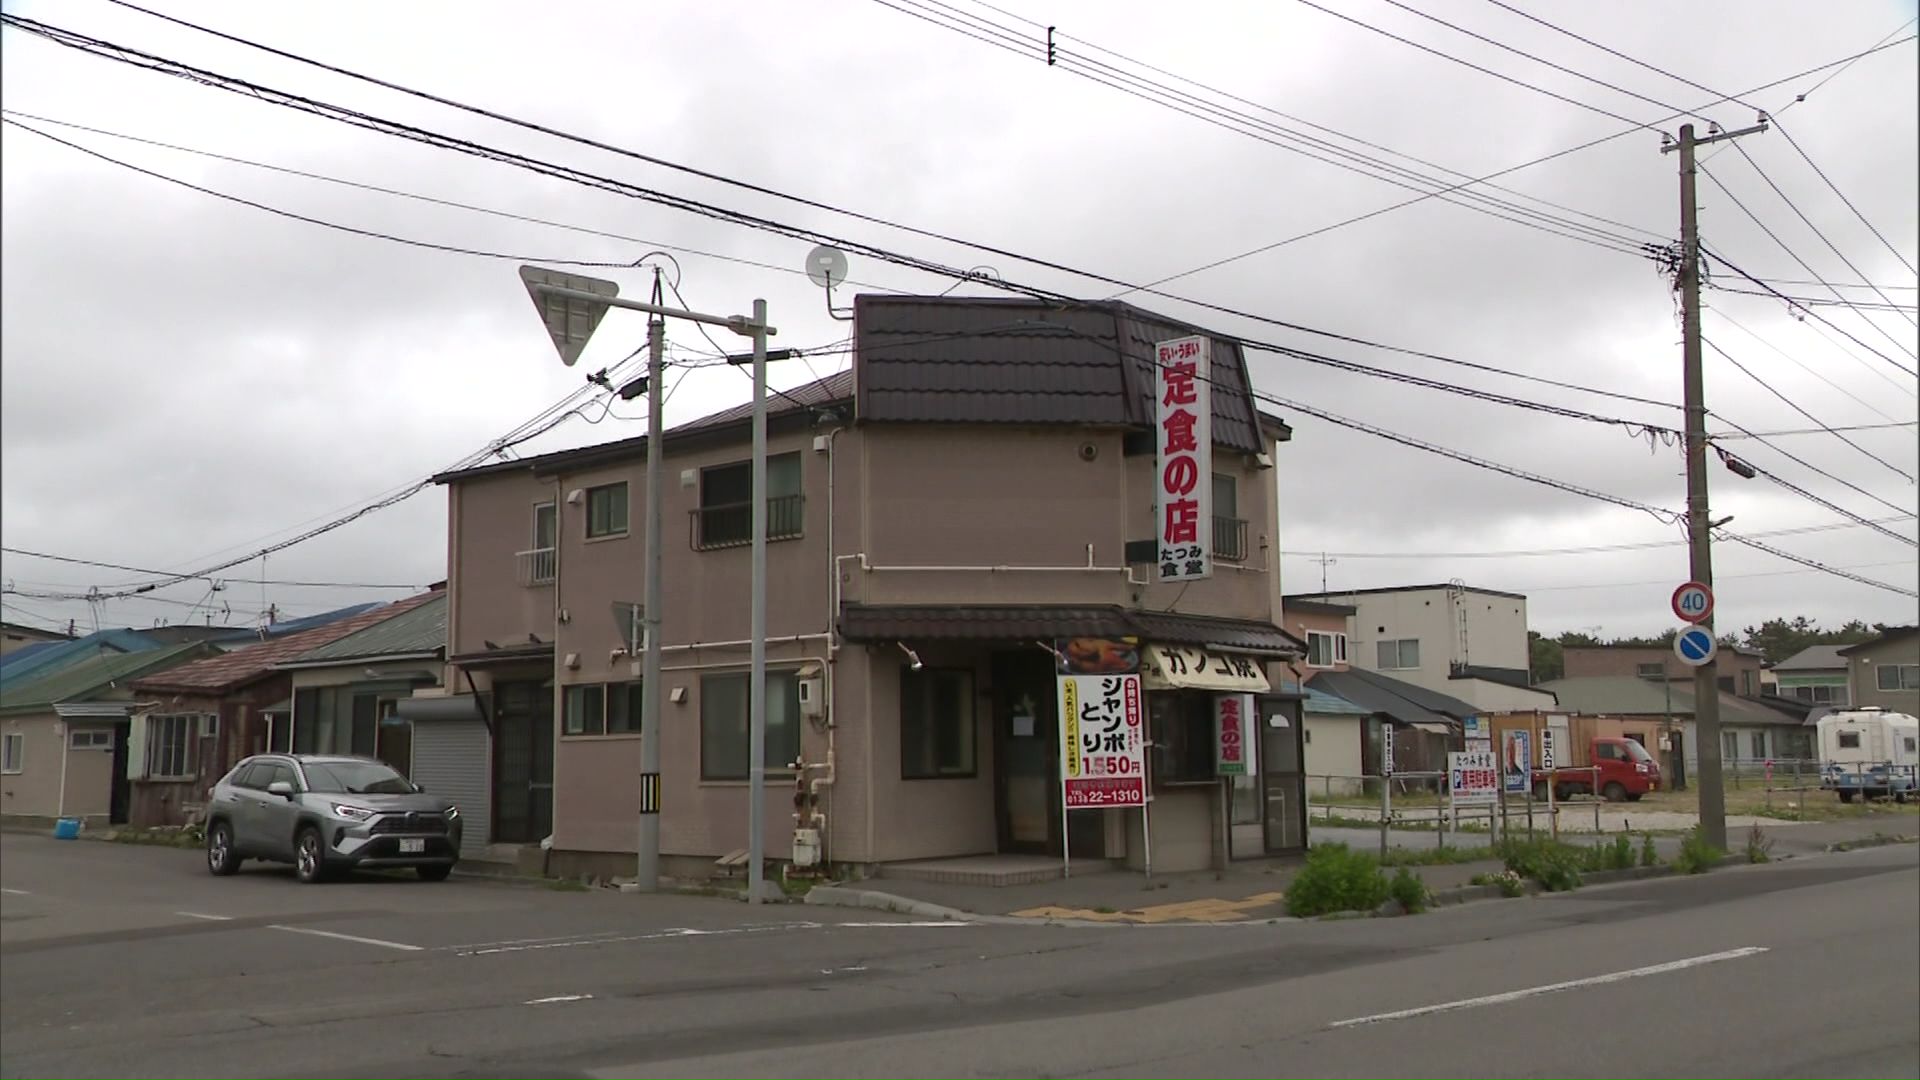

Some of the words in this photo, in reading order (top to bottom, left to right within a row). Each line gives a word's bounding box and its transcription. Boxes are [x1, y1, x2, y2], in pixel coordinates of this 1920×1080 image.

[1163, 361, 1198, 544] 定食の店
[1161, 546, 1202, 560] たつみ
[1161, 560, 1203, 577] 食堂
[1682, 593, 1704, 611] 40
[1081, 703, 1100, 753] とり
[1220, 698, 1240, 762] 定食の店
